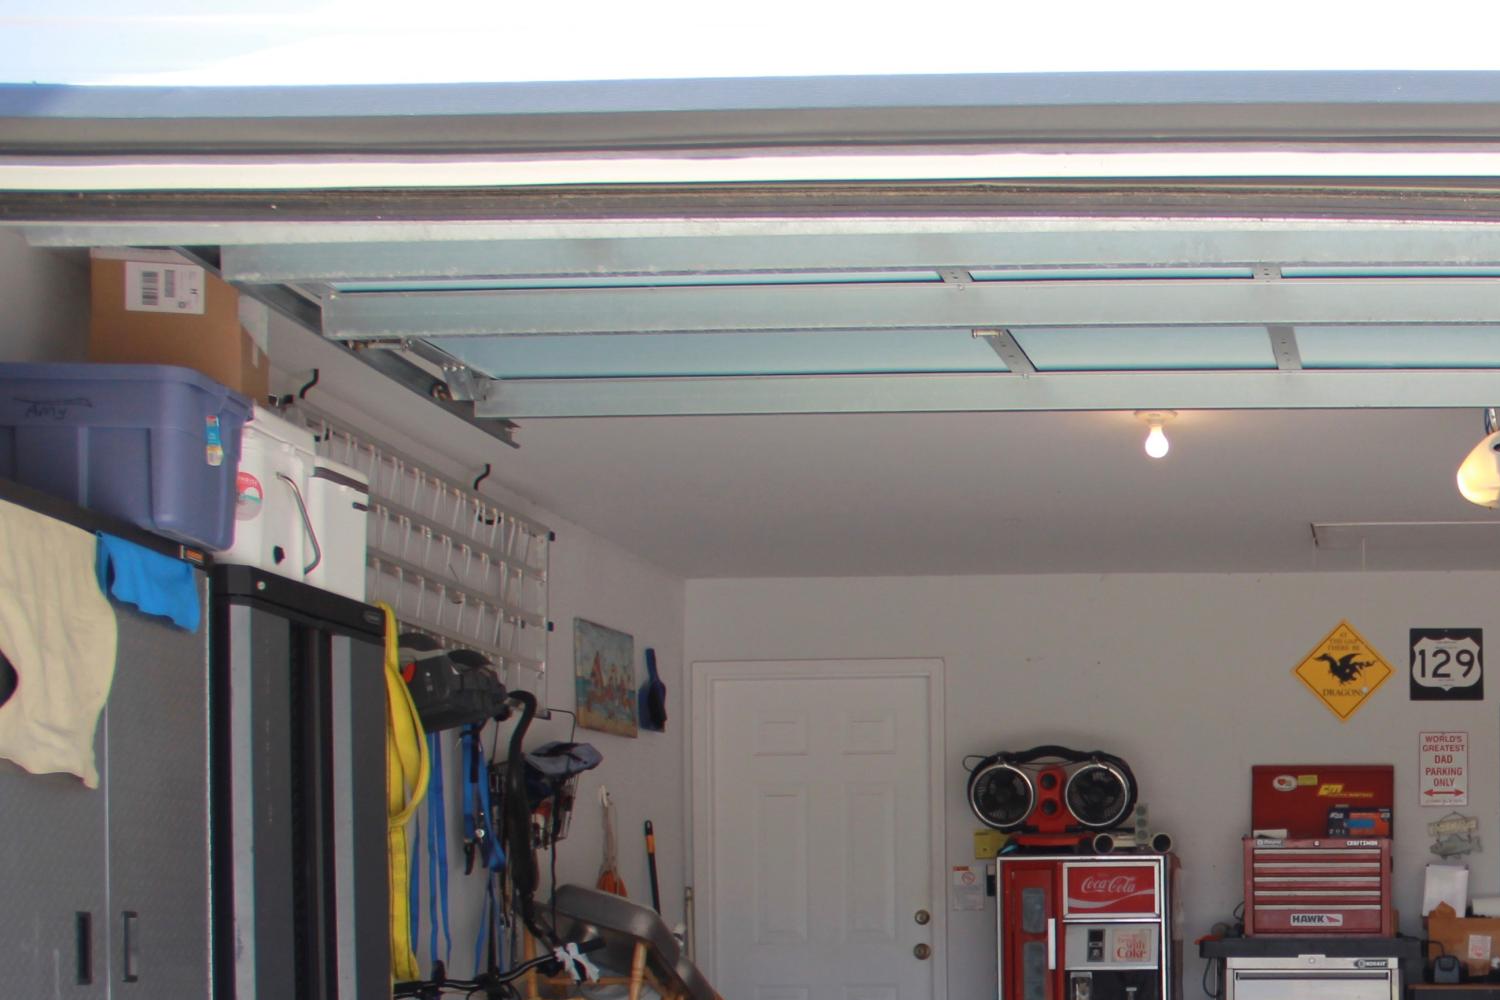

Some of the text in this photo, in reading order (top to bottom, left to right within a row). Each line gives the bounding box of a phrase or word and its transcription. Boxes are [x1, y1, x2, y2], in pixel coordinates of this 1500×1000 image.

[1418, 649, 1475, 678] 129
[1425, 735, 1463, 743] WORLD'S
[1422, 744, 1465, 752] GREATEST
[1434, 755, 1453, 764] DAD
[1425, 767, 1463, 776] PARKING
[1433, 778, 1455, 787] ONLY
[1292, 915, 1325, 923] HAWK
